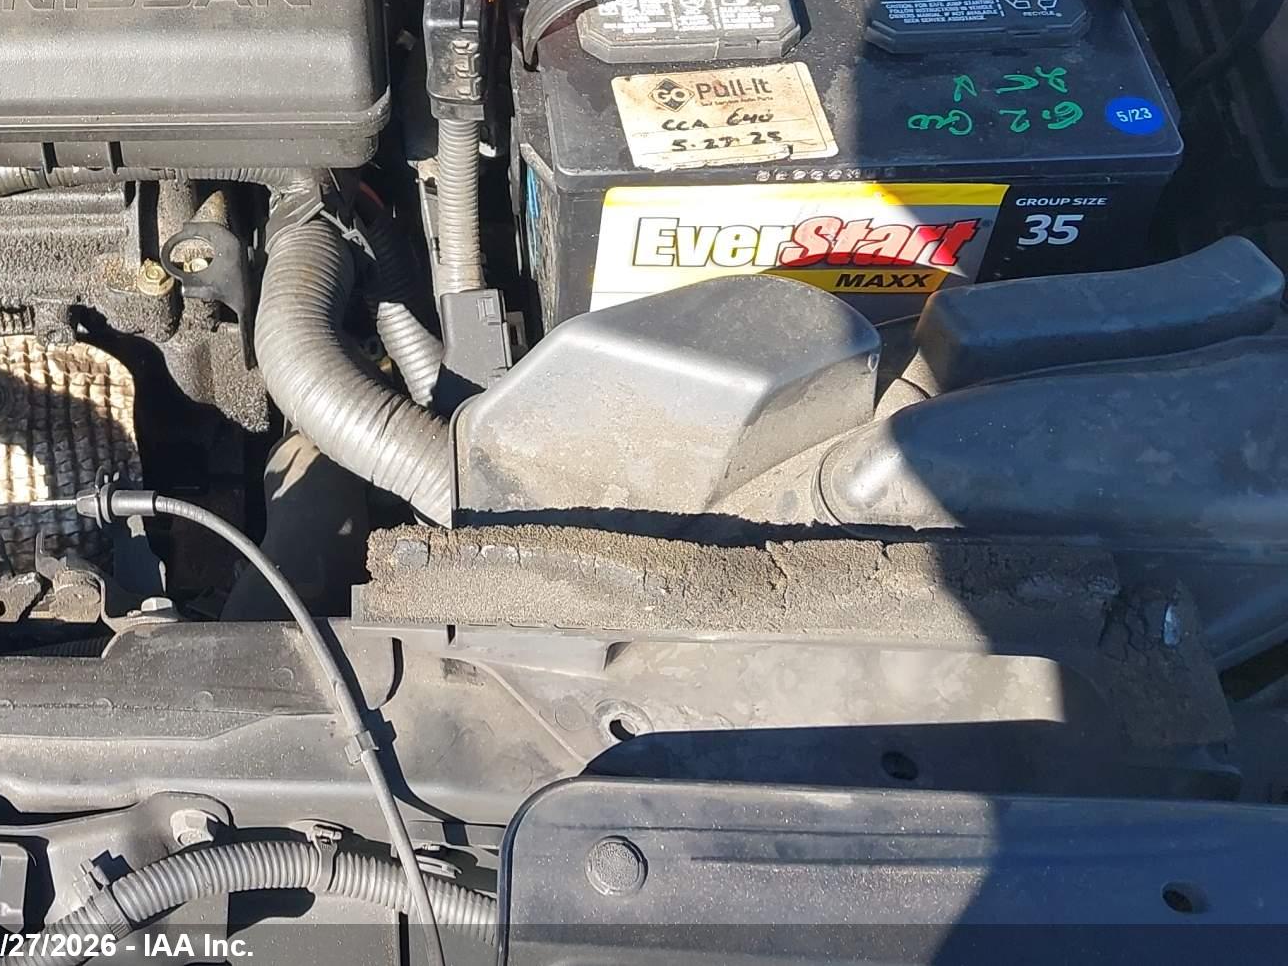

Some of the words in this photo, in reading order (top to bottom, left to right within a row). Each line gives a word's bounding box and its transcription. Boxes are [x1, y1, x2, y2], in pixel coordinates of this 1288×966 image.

[1116, 106, 1153, 124] 5/23
[1014, 197, 1074, 208] GROUP
[1076, 196, 1108, 207] SIZE
[1017, 213, 1086, 247] 35
[632, 215, 982, 269] EverStart
[834, 272, 935, 290] MAXX
